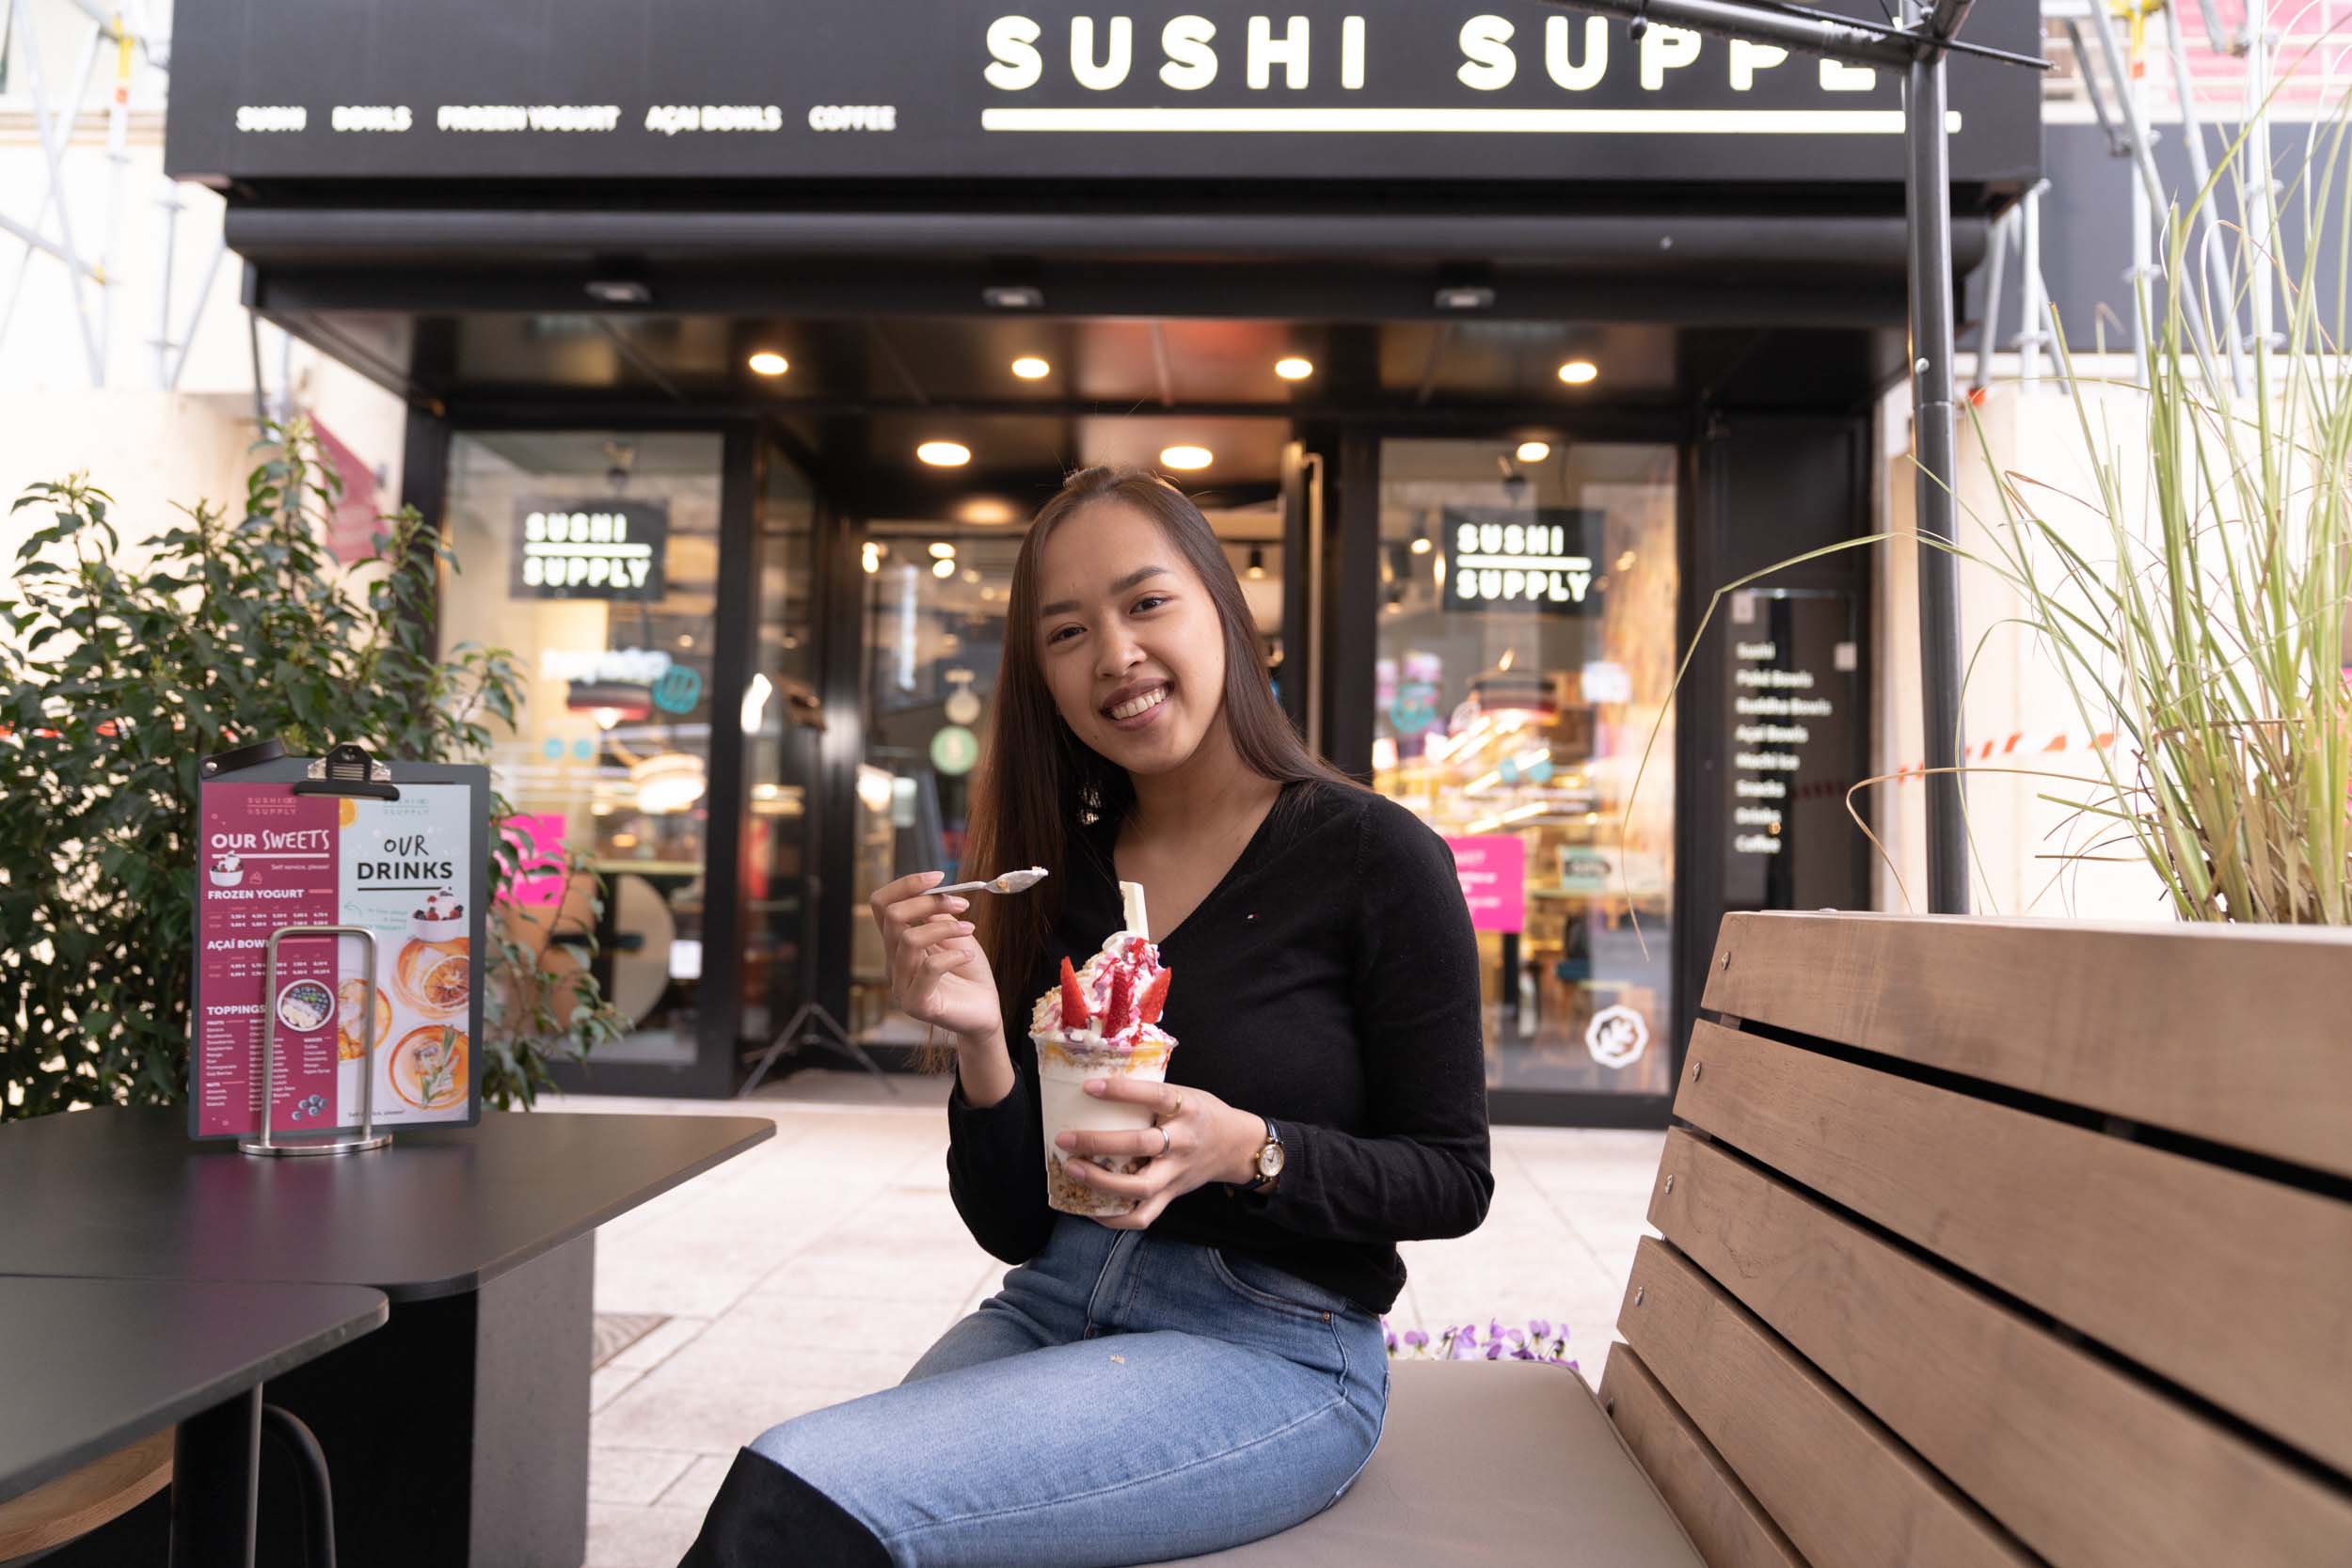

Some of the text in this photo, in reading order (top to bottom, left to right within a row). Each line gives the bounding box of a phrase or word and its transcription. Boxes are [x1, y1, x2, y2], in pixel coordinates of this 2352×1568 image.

[984, 14, 1904, 91] SUSHI SUPPL
[525, 512, 627, 543] SUSHI
[1457, 523, 1564, 555] SUSHI
[523, 556, 651, 587] SUPPLY
[1456, 569, 1592, 602] SUPPLY
[211, 830, 329, 850] OUR SWEETS
[384, 834, 429, 857] OUR
[358, 862, 453, 879] DRINKS
[208, 889, 305, 900] FROZEN YOGURT
[207, 938, 235, 951] AÇAÍ
[207, 1005, 266, 1016] TOPPINGS
